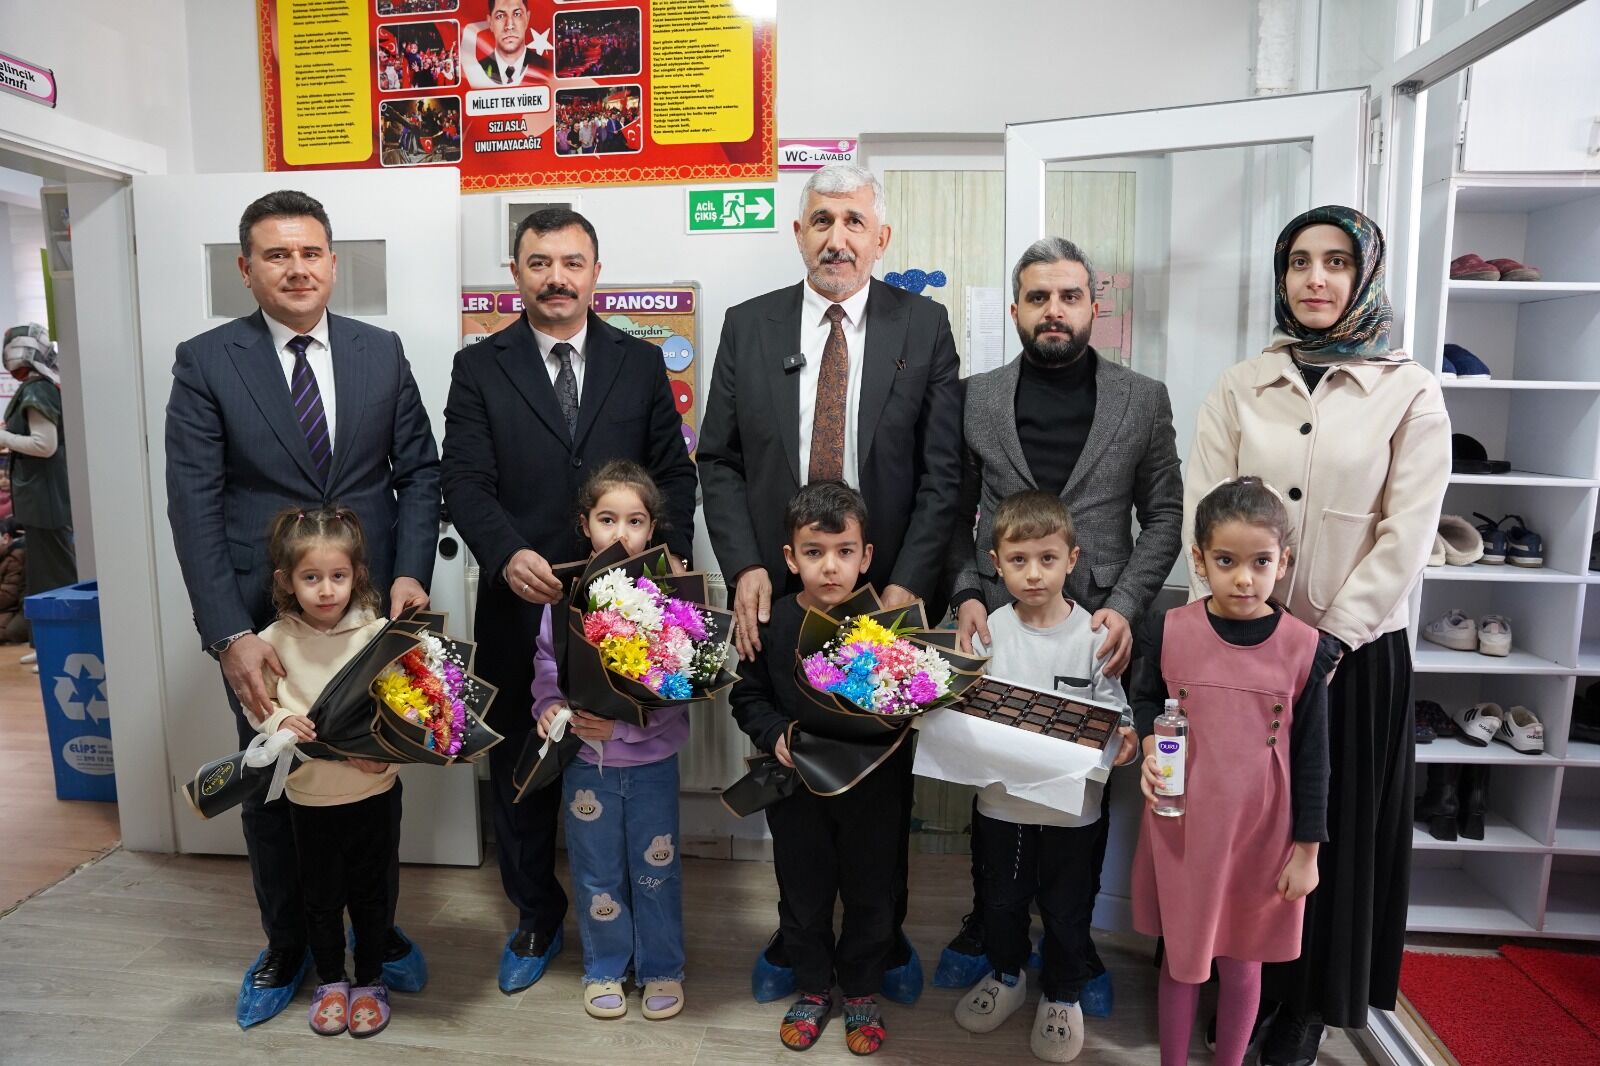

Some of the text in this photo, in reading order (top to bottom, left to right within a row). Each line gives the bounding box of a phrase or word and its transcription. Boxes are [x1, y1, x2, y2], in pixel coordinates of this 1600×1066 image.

[472, 93, 543, 110] MİLLET TEK YÜREK
[488, 119, 527, 133] SİZİ ASLA
[475, 136, 543, 153] UNUTMAYACAĞIZ
[696, 200, 716, 212] ACİL
[694, 211, 718, 223] ÇIKIŞ
[605, 295, 678, 310] PANOSU
[622, 327, 663, 338] ünaydın
